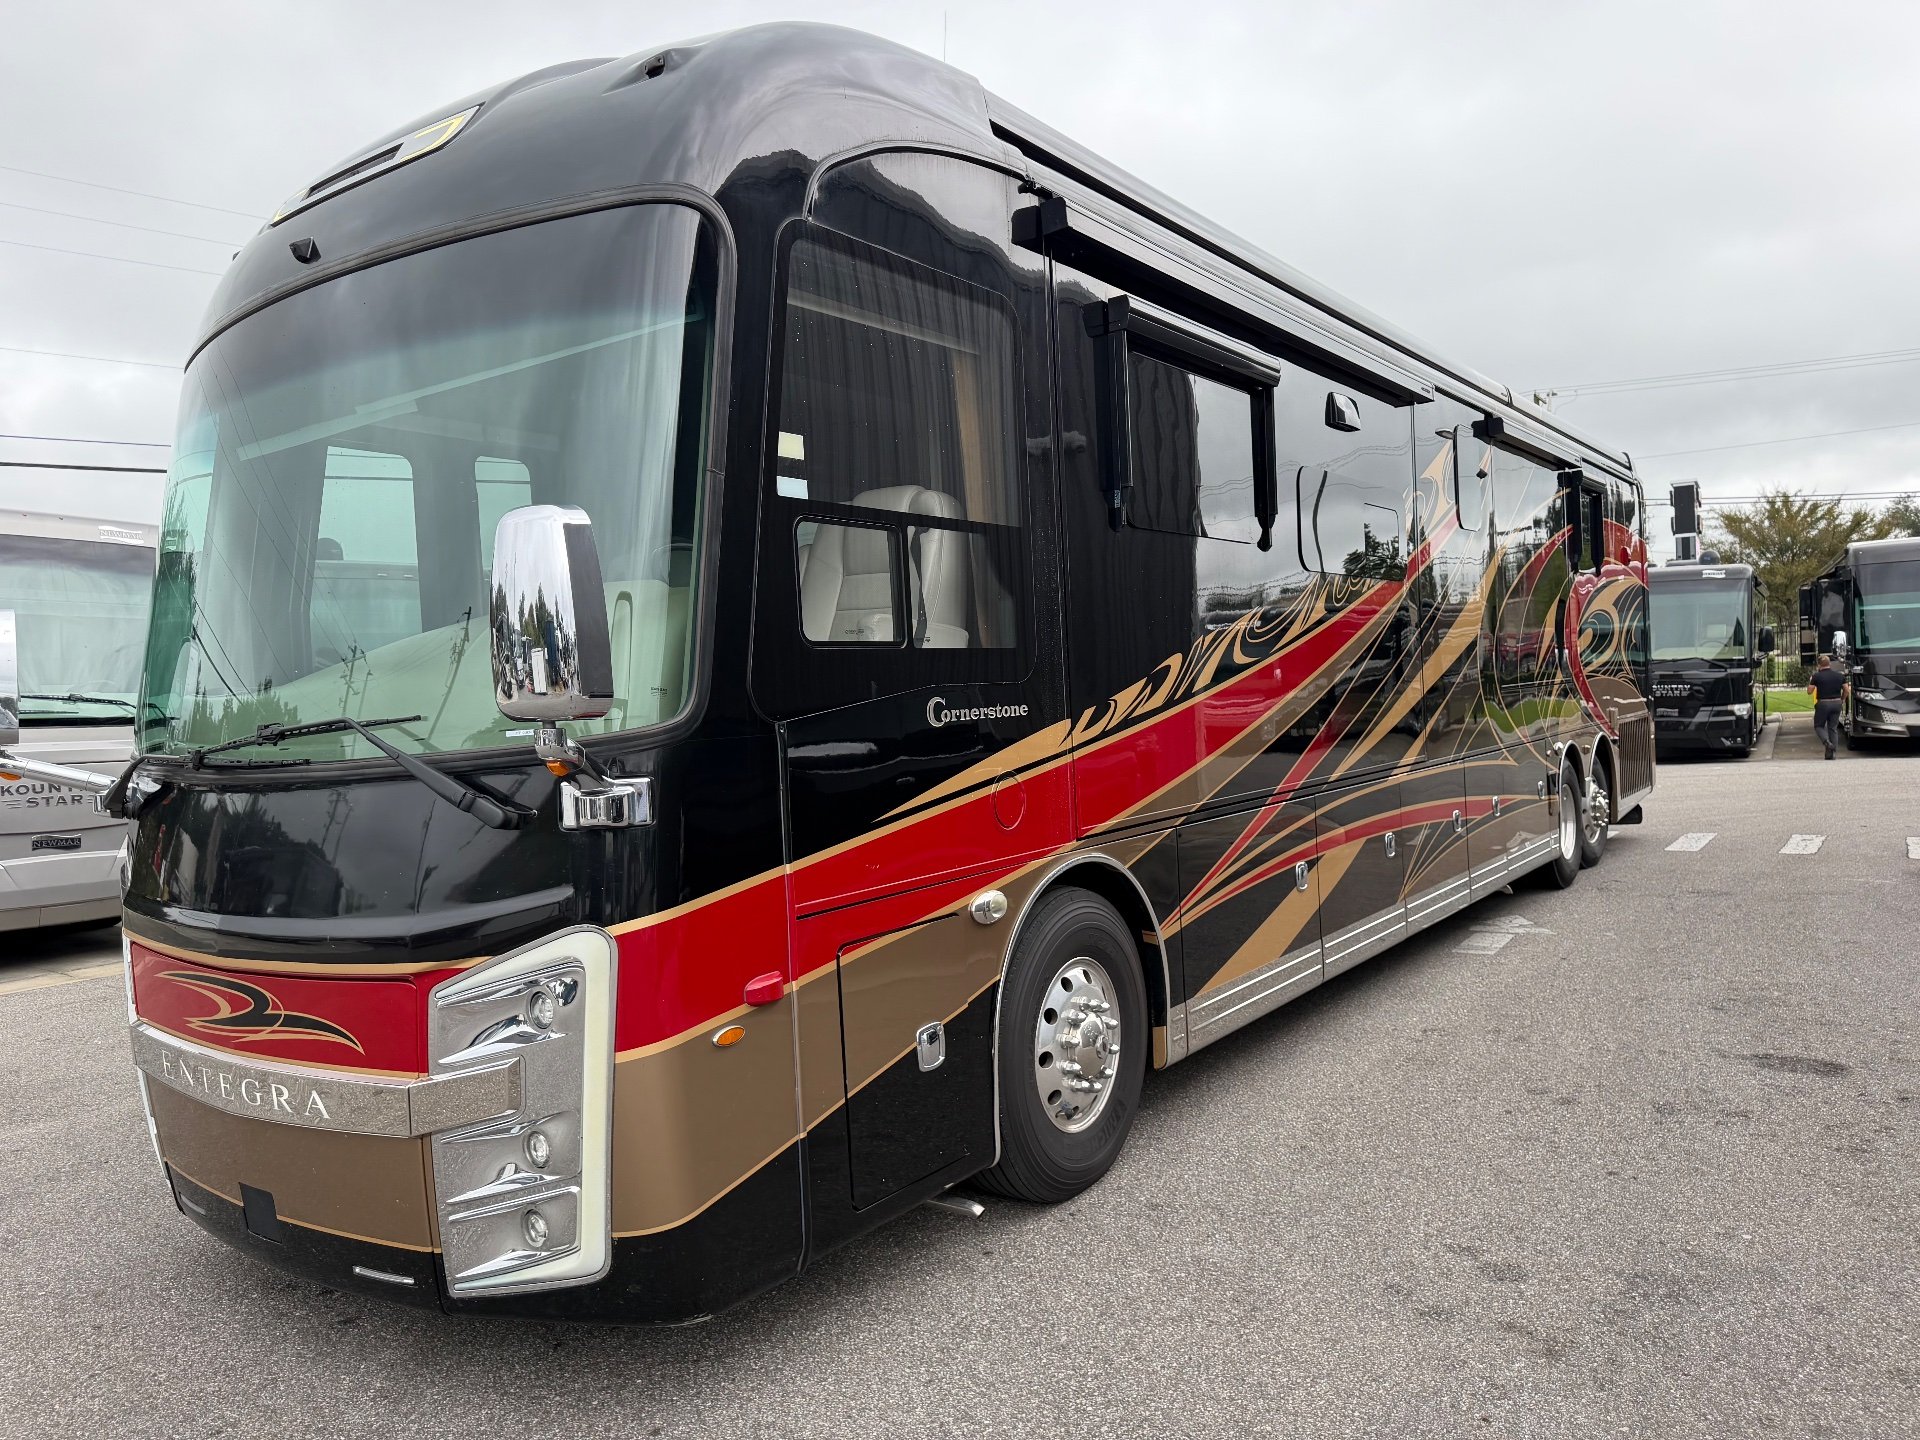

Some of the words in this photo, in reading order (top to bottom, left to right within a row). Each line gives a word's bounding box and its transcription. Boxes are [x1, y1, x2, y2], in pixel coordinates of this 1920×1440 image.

[926, 696, 1029, 727] Cornerstone
[0, 783, 84, 797] KOUN
[26, 794, 84, 809] STAR
[33, 838, 81, 848] NEWMAR
[161, 1049, 331, 1120] ENTEGRA
